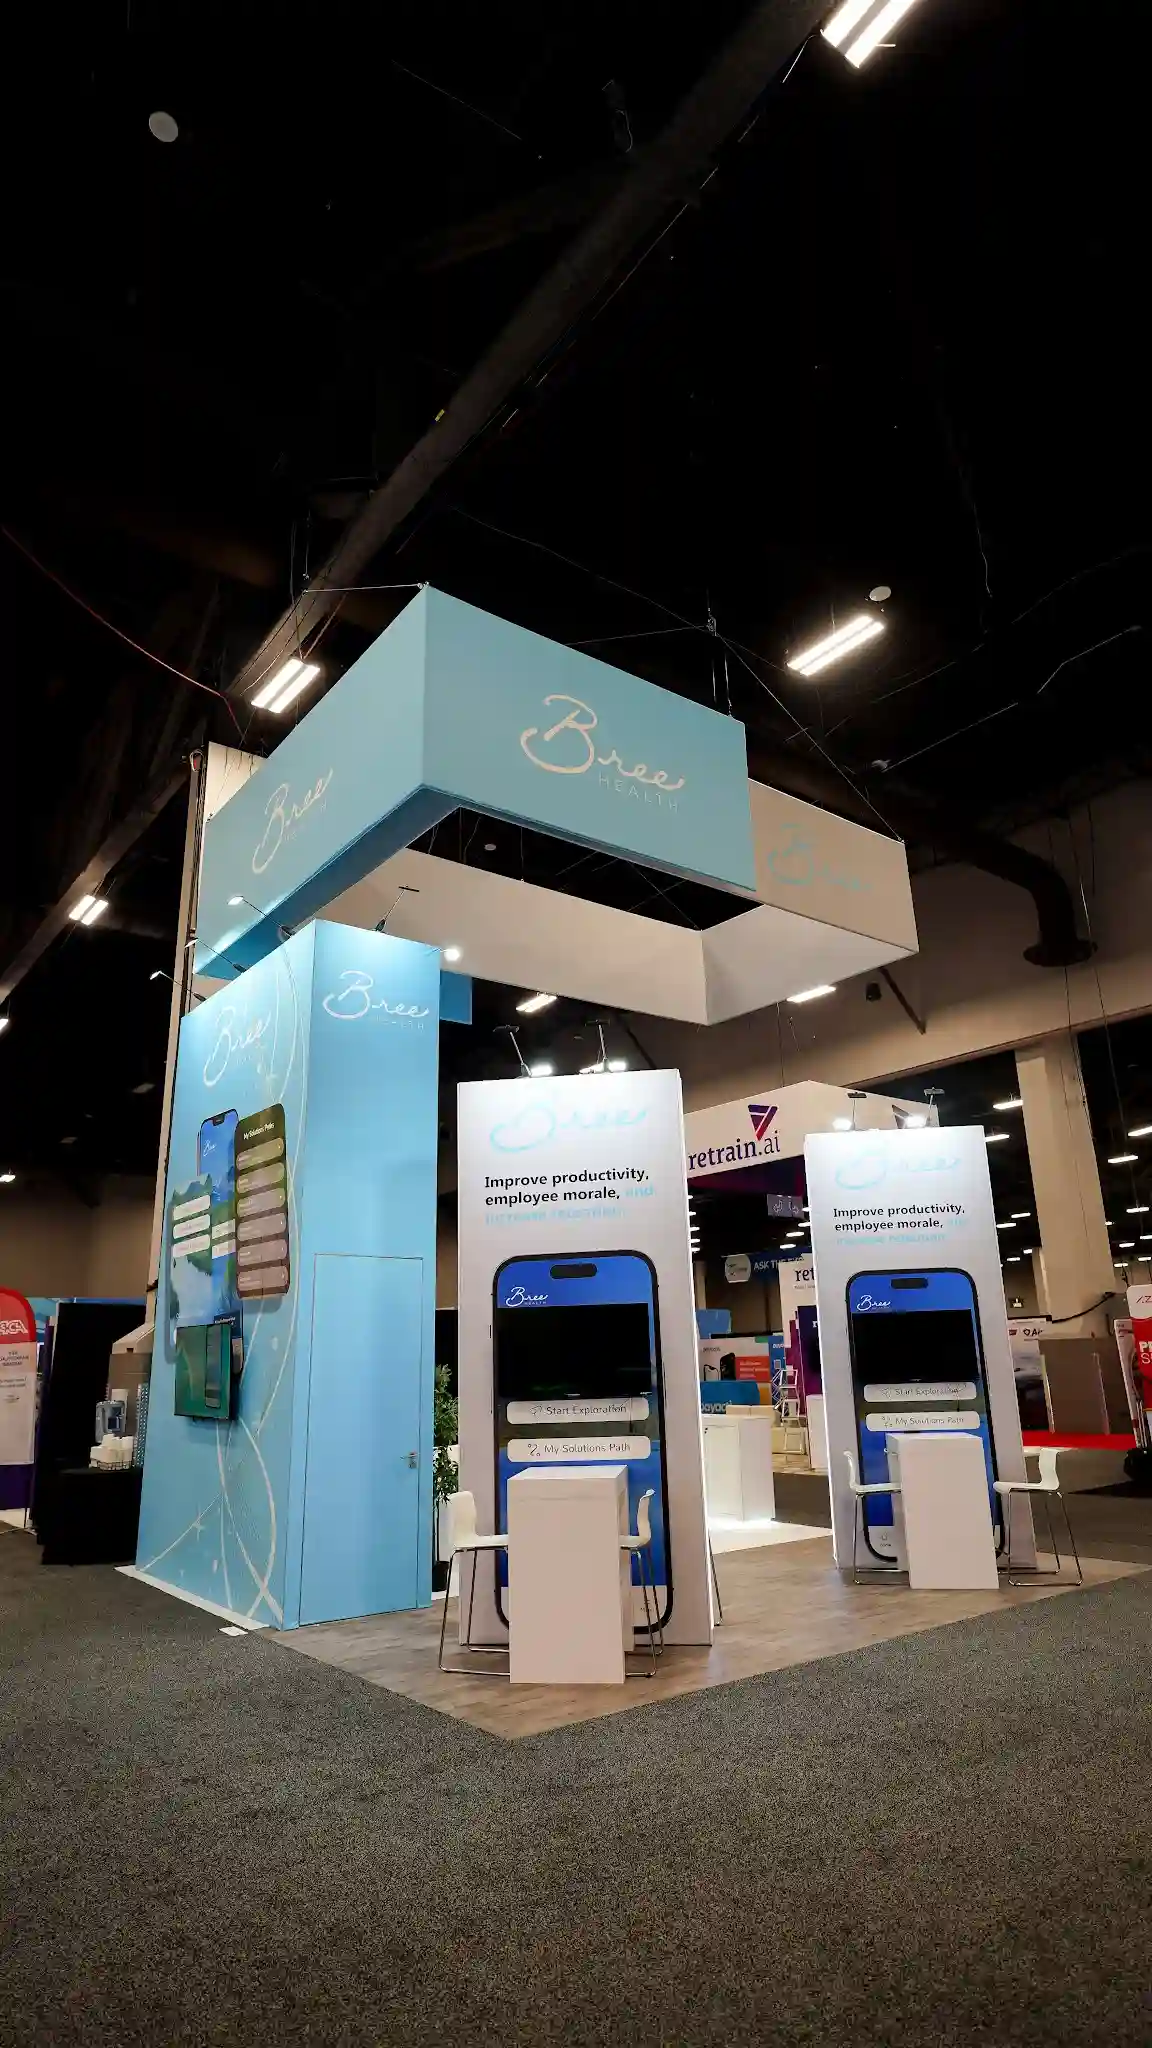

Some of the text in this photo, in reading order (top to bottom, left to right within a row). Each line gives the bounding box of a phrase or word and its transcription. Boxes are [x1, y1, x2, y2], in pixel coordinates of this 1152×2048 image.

[520, 693, 685, 791] Bree
[598, 770, 679, 813] HEALTH
[252, 766, 334, 874] Bree
[322, 968, 430, 1020] Bree
[203, 1005, 272, 1087] Bree
[688, 1130, 780, 1170] retrain.ai
[485, 1168, 649, 1190] Improve productivity,
[485, 1191, 559, 1208] employee
[563, 1187, 620, 1201] morale,
[833, 1203, 965, 1219] Improve productivity,
[834, 1220, 894, 1233] employee
[897, 1217, 943, 1229] morale,
[753, 1261, 770, 1271] ASK
[505, 1286, 549, 1307] Bree
[856, 1294, 891, 1311] Bree
[546, 1404, 627, 1415] Start Exploration
[896, 1417, 908, 1426] My
[544, 1442, 631, 1455] My Solutions Path
